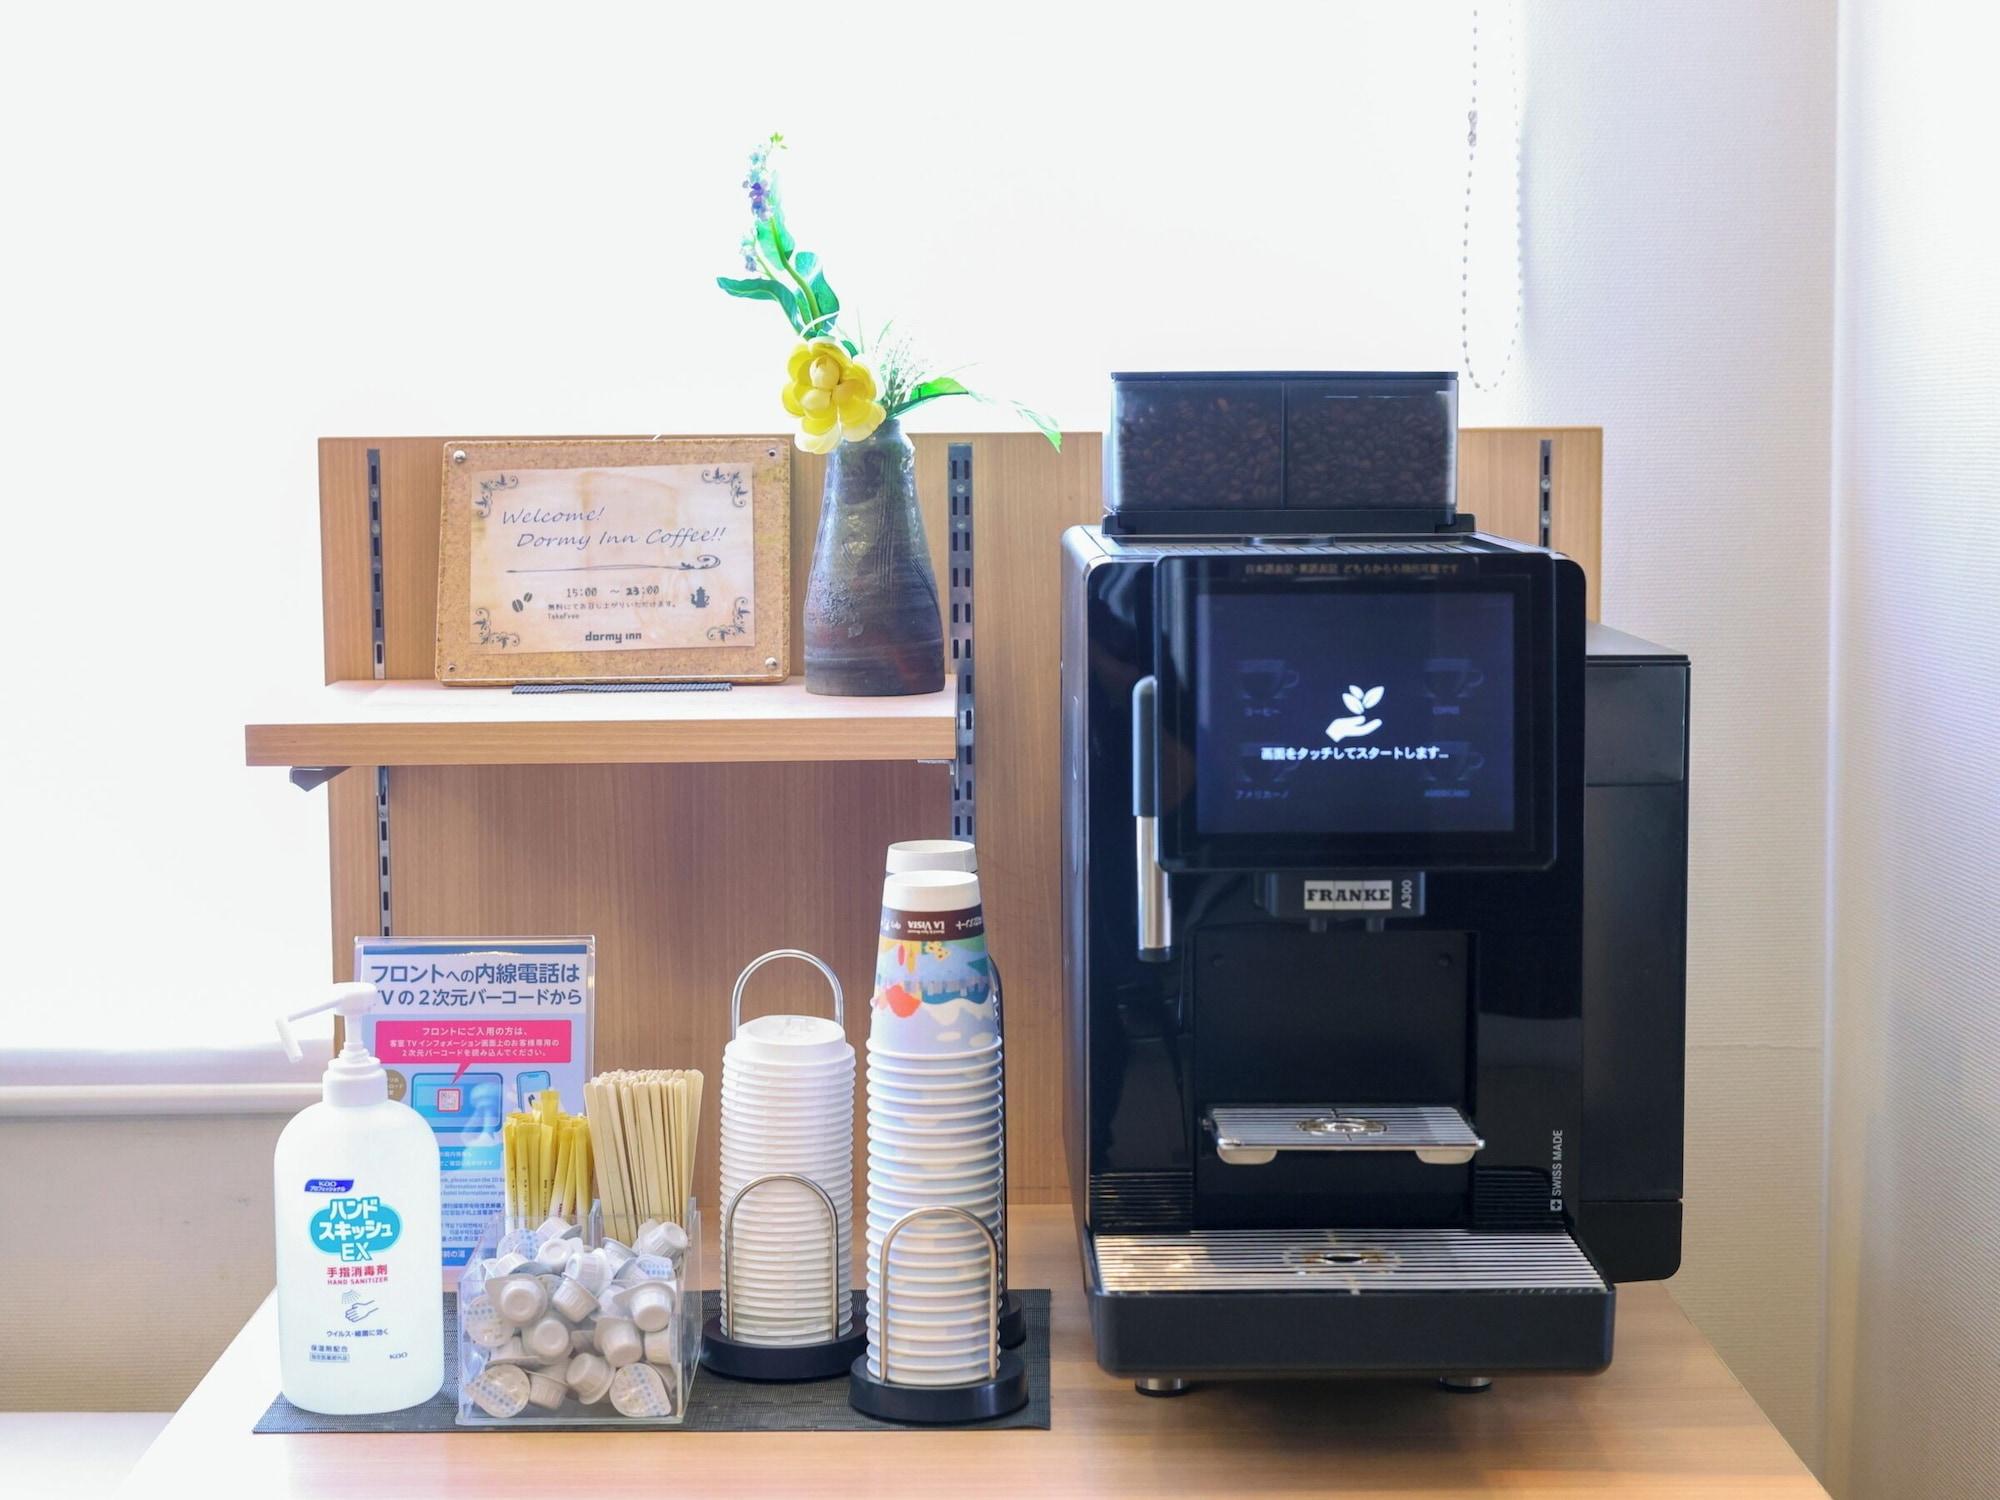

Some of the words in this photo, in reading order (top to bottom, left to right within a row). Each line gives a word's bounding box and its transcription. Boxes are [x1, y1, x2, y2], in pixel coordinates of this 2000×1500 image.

[502, 507, 605, 524] Welcome!
[517, 533, 591, 550] Dormy
[599, 531, 638, 545] Inn
[645, 527, 728, 548] Coffee!!
[567, 587, 597, 598] 15:00
[626, 585, 660, 596] 23:00
[585, 631, 622, 643] dormy
[625, 632, 642, 640] inn
[1307, 889, 1390, 902] FRANKE
[1401, 880, 1413, 909] A300
[907, 920, 932, 930] VISTA
[370, 963, 581, 985] フロントへの内線電話は
[377, 988, 582, 1007] Vの2次元バーコードから
[422, 1026, 528, 1037] フロントにご入用の方は、
[1552, 1129, 1563, 1160] MADE
[1552, 1163, 1562, 1196] SWISS
[329, 1198, 380, 1220] ハンド
[318, 1219, 393, 1241] スキッシュ
[341, 1242, 372, 1261] EX
[327, 1264, 388, 1278] 手指消毒剤
[350, 1277, 388, 1285] SANITIZER
